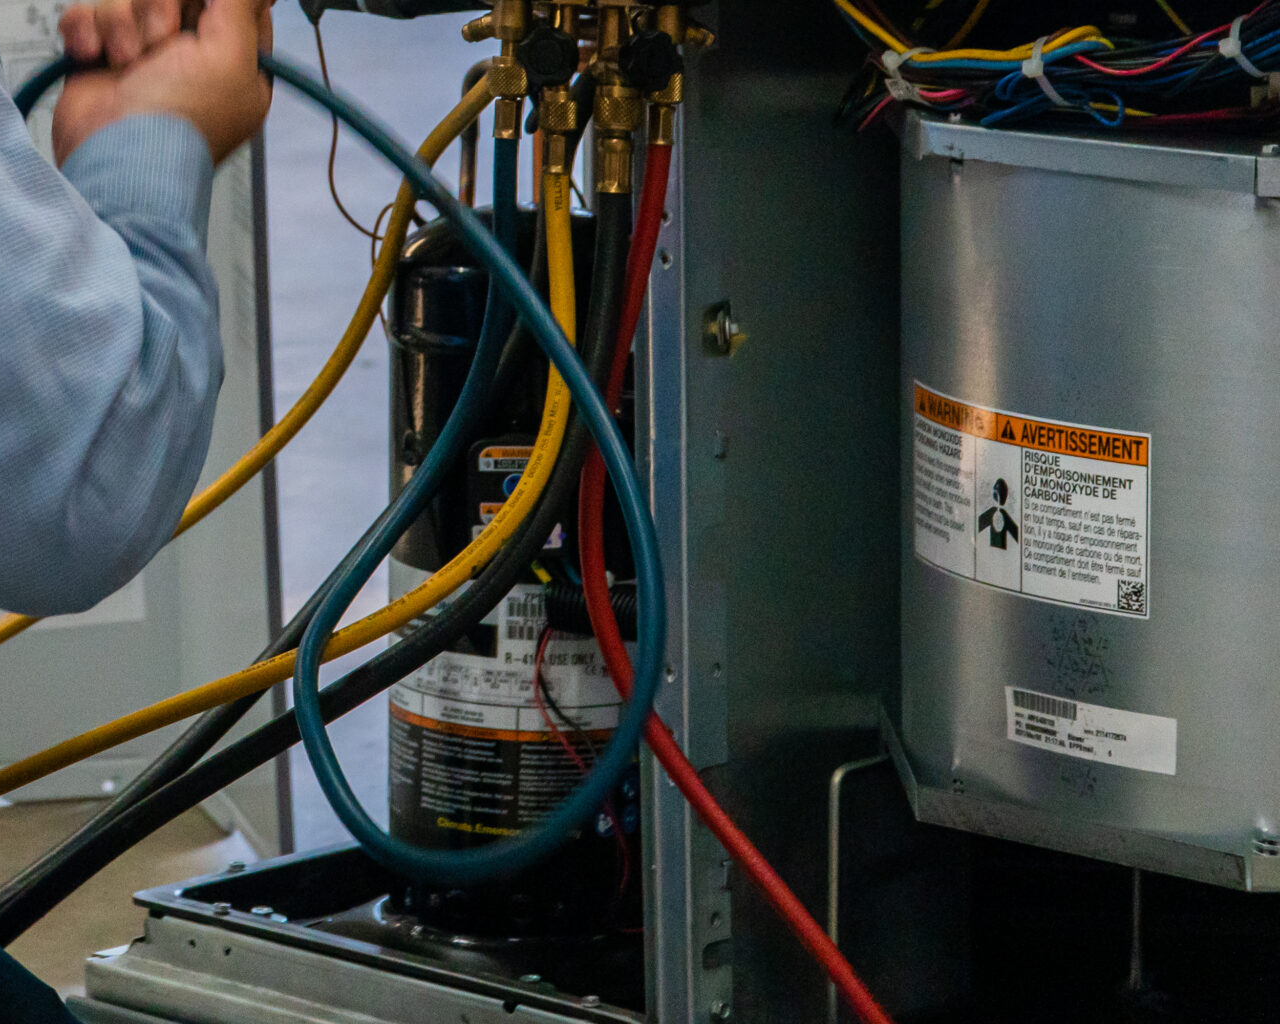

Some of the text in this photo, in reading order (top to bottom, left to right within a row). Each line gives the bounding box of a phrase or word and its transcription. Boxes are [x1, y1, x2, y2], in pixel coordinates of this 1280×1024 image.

[928, 395, 985, 431] WARNING
[1021, 423, 1144, 462] AVERTISSEMENT
[1024, 450, 1061, 467] RISQUE
[1024, 463, 1134, 491] D'EMPOISONNEMENT
[1024, 475, 1118, 501] AU MONOXYDE DE
[1024, 486, 1073, 506] CARBONE
[1023, 512, 1032, 522] en
[1033, 513, 1045, 525] tout
[1068, 521, 1082, 532] sauf
[1083, 524, 1092, 533] en
[1093, 525, 1105, 536] cas
[1106, 527, 1116, 537] de
[1031, 501, 1039, 511] ce
[1039, 503, 1083, 518] compartiment
[1102, 514, 1115, 525] pas
[1115, 513, 1137, 528] fermé
[1032, 539, 1065, 555] monoxyde
[1065, 542, 1074, 553] de
[1075, 545, 1103, 560] carbone
[1103, 551, 1113, 562] ou
[1113, 552, 1123, 563] de
[1053, 530, 1073, 543] risque
[1073, 534, 1138, 553] d'empoisonnement
[1023, 547, 1033, 559] Ce
[1033, 551, 1076, 566] compartiment
[1076, 559, 1090, 570] doit
[1104, 562, 1125, 576] fermé
[1126, 566, 1142, 578] sauf
[1032, 563, 1057, 575] moment
[1058, 568, 1067, 579] de
